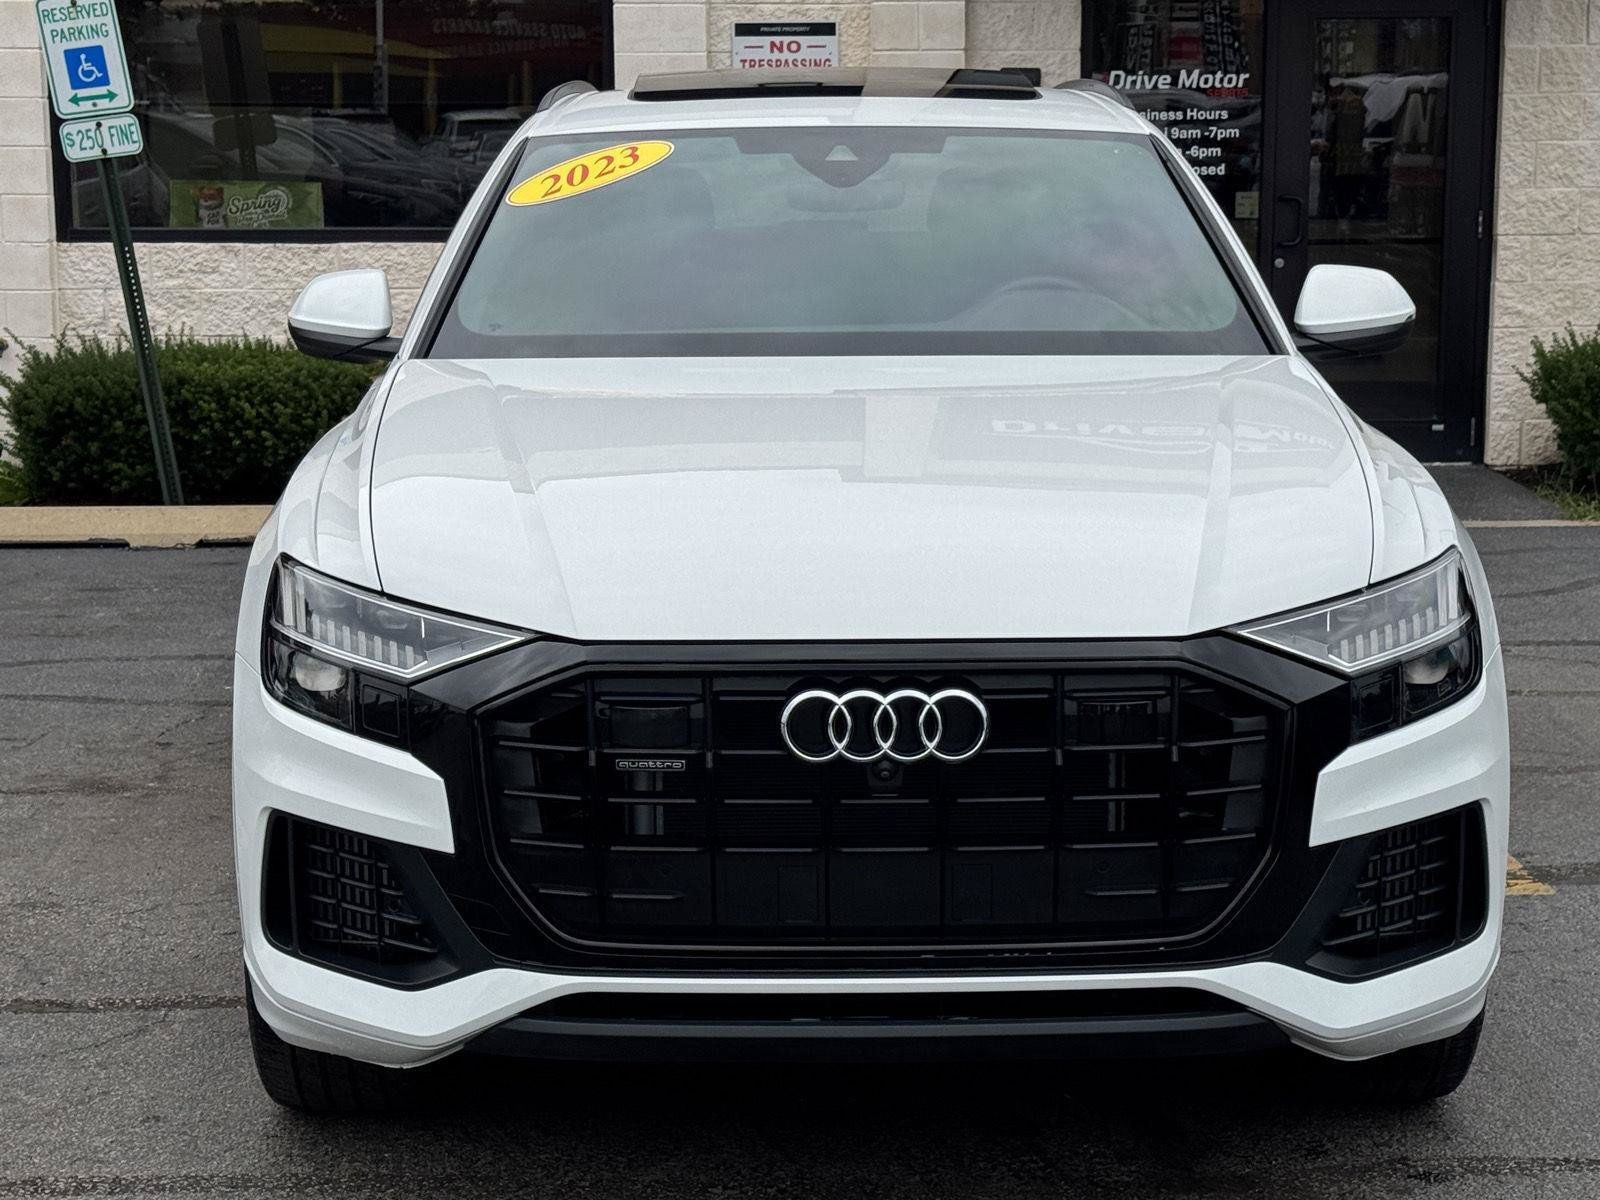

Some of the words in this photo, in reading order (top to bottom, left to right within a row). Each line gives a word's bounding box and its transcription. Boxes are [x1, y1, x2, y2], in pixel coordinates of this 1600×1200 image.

[41, 1, 110, 24] RESERVED
[50, 23, 110, 44] PARKING
[769, 40, 802, 54] NO
[739, 58, 832, 69] TRESPASSING
[1108, 69, 1172, 90] Drive
[1177, 69, 1250, 89] Motor
[1138, 109, 1183, 120] siness
[1187, 108, 1228, 120] Hours
[64, 125, 105, 151] $250
[108, 122, 139, 147] FINE
[1171, 127, 1201, 139] 9am
[1204, 126, 1240, 141] -7pm
[540, 145, 640, 198] 2023
[1192, 163, 1225, 176] osed
[228, 196, 283, 215] Spring
[618, 760, 683, 769] quattro
